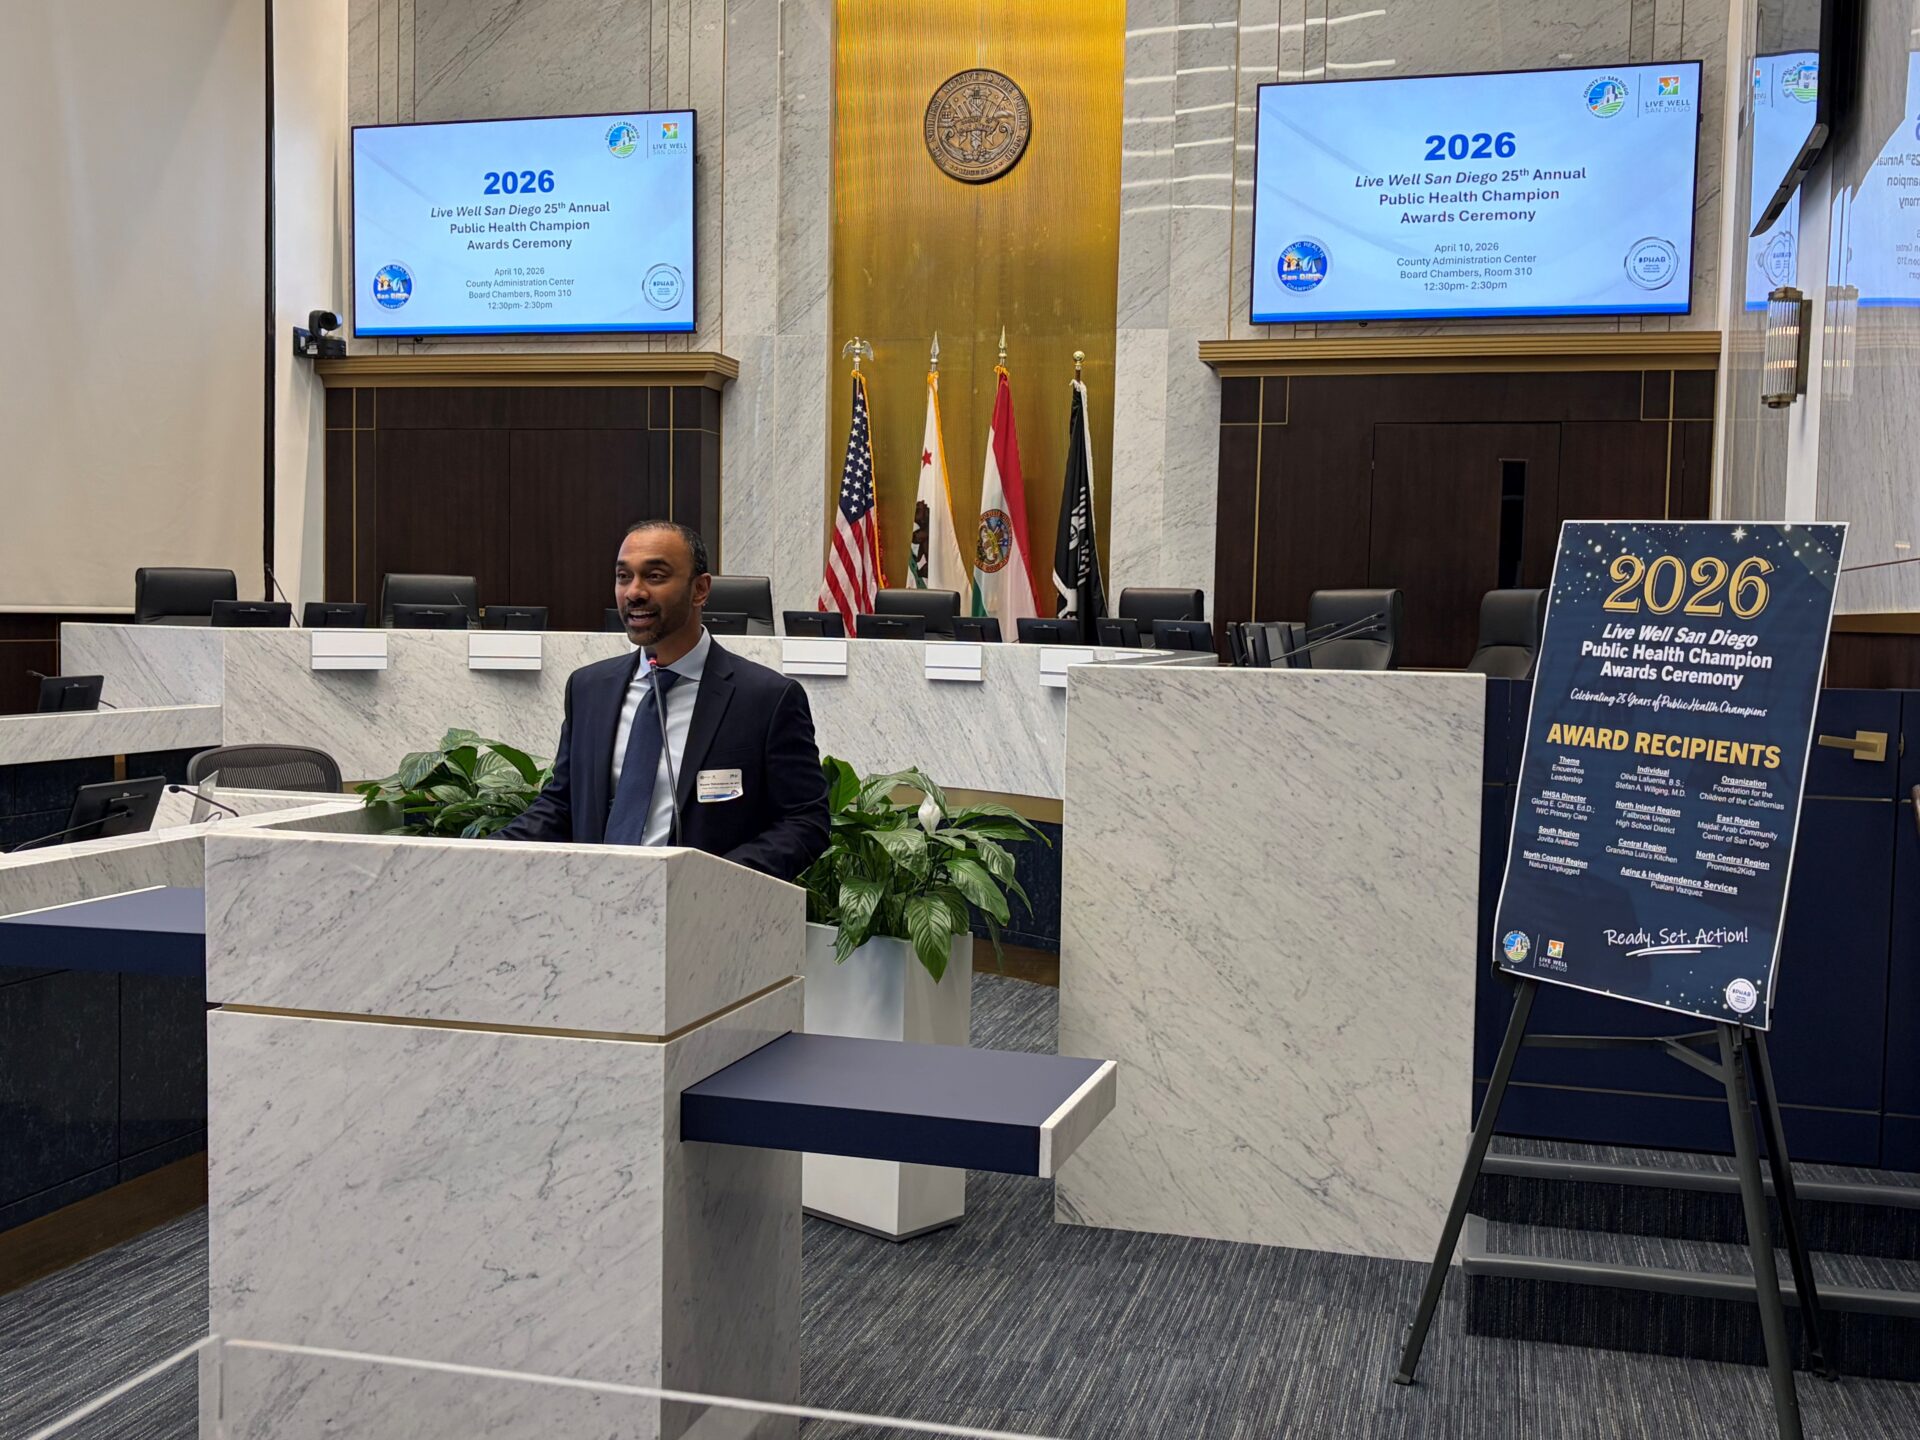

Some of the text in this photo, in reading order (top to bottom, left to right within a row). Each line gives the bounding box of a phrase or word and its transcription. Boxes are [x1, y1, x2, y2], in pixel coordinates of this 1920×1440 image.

[1645, 100, 1664, 108] LIVE
[1424, 131, 1516, 161] 2026
[484, 170, 555, 195] 2026
[1355, 167, 1586, 188] Live Well San Diego 25th Annual
[1379, 188, 1560, 206] Public Health Champion
[431, 202, 610, 218] Live Well San Diego 25th Annual
[1401, 209, 1536, 224] Awards Ceremony
[450, 219, 590, 234] Public Health Champion
[467, 238, 572, 250] Awards Ceremony
[1434, 242, 1499, 254] April 10, 2026
[1397, 254, 1536, 267] County Administration Center
[494, 267, 545, 276] April 10, 2026
[1400, 267, 1532, 279] Board Chambers, Room 310
[466, 278, 574, 288] County Administration Center
[1424, 281, 1507, 292] 12:30pm- 2:30pm
[468, 291, 490, 299] Board
[491, 290, 533, 298] Chambers,
[558, 289, 571, 297] 310
[524, 301, 552, 309] 2:30pm
[1602, 555, 1774, 619] 2026
[1602, 623, 1758, 650] Live Well San Diego
[1581, 641, 1772, 669] Public Health Champion
[1600, 661, 1744, 690] Awards Ceremony
[1570, 688, 1768, 718] Celebrating 25 Years of Public Health Champions
[1546, 723, 1781, 769] AWARD RECIPIENTS
[1559, 756, 1580, 766] Theme
[1552, 764, 1584, 775] Encuentros
[1637, 765, 1670, 777] Individual
[1551, 773, 1583, 784] Leadership
[1620, 773, 1637, 781] Olivia
[1721, 775, 1767, 789] Organization
[1542, 790, 1586, 803] HHSA Director
[1615, 782, 1686, 797] Stefan M.D.
[1713, 784, 1749, 795] Foundation
[1751, 789, 1761, 797] for
[1531, 798, 1549, 806] Gloria
[1699, 792, 1726, 802] Children
[1728, 796, 1735, 804] of
[1748, 799, 1785, 810] Californias
[1549, 810, 1572, 820] Primary
[1573, 813, 1587, 821] Care
[1615, 800, 1680, 817] North Inland Region
[1623, 811, 1670, 823] Fallbrook Union
[1716, 814, 1760, 828] East Region
[1538, 826, 1580, 839] South Region
[1616, 819, 1675, 834] High School District
[1721, 825, 1738, 833] Arab
[1739, 827, 1778, 840] Community
[1537, 835, 1554, 843] Jovita
[1618, 838, 1667, 853] Central Region
[1702, 832, 1725, 841] Center
[1734, 836, 1747, 845] San
[1749, 839, 1769, 849] Diego
[1523, 850, 1588, 869] North Coastal Region
[1605, 845, 1633, 856] Grandma
[1654, 852, 1678, 863] Kitchen
[1696, 850, 1770, 870] North Central Region
[1529, 861, 1580, 875] Nature Unplugged
[1706, 862, 1756, 877] Promises2Kids
[1621, 867, 1640, 878] Aging
[1648, 871, 1701, 888] Independence
[1704, 880, 1738, 895] Services
[1676, 885, 1703, 897] Vazquez
[1603, 926, 1749, 947] Ready. Set. Action!
